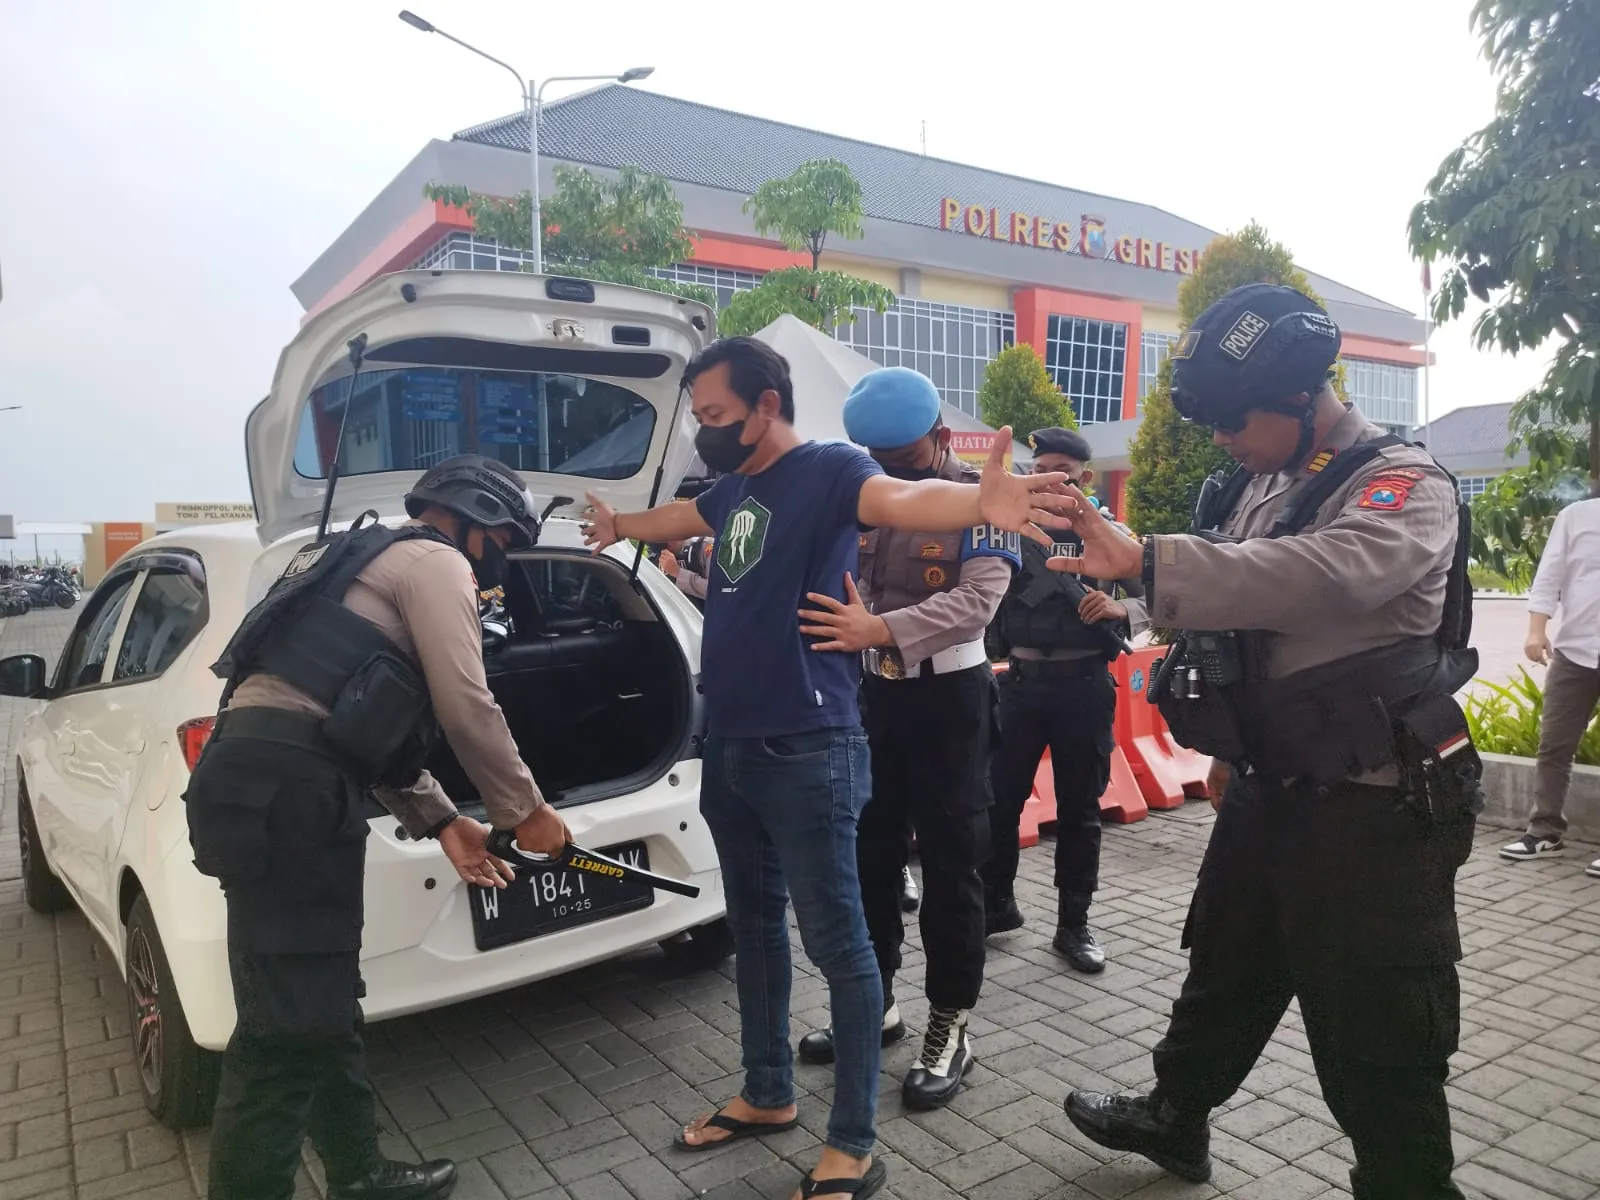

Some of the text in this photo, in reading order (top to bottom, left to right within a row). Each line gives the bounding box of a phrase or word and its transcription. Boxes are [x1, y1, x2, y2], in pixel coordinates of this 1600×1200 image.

[940, 198, 1203, 275] POLRES GRESI
[1224, 314, 1265, 355] POLICE
[952, 436, 996, 449] HATIA
[568, 856, 625, 878] GARRETT
[481, 886, 499, 921] W
